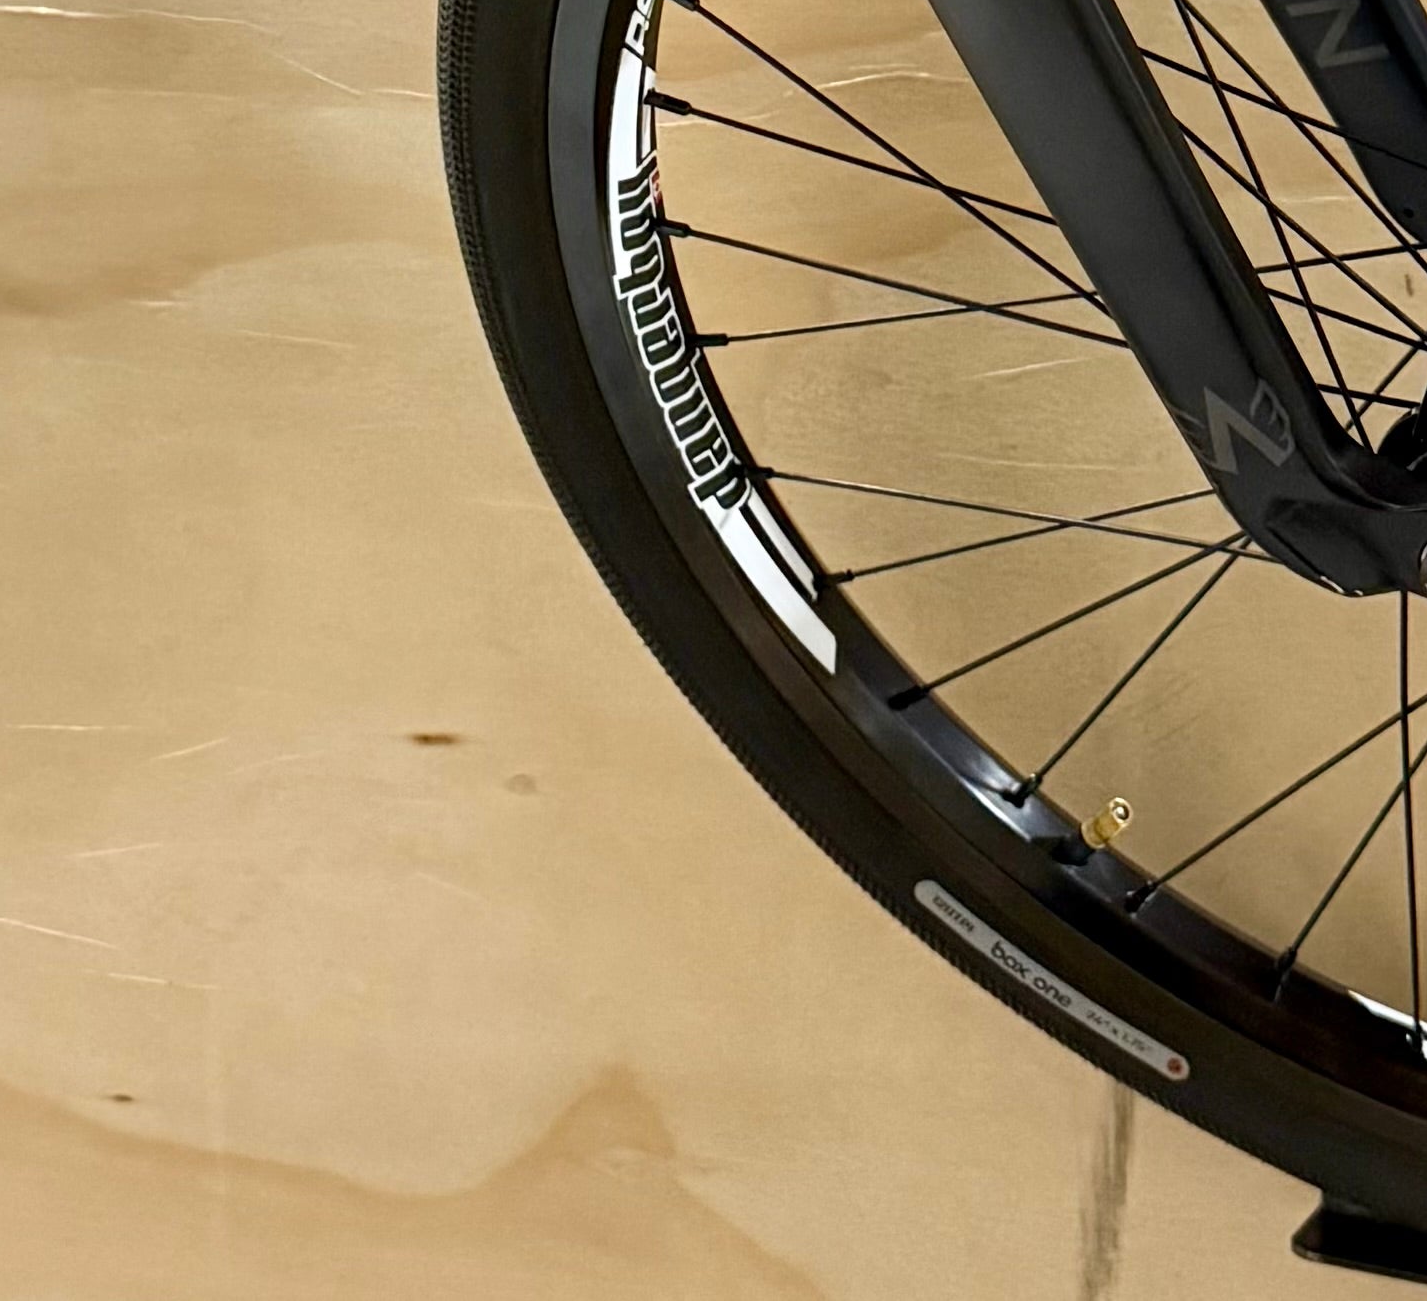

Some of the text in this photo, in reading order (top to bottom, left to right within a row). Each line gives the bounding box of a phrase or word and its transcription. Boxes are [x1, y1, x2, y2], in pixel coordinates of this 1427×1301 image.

[613, 151, 754, 511] dangerboy
[990, 940, 1029, 981] box
[1033, 976, 1072, 1009] one
